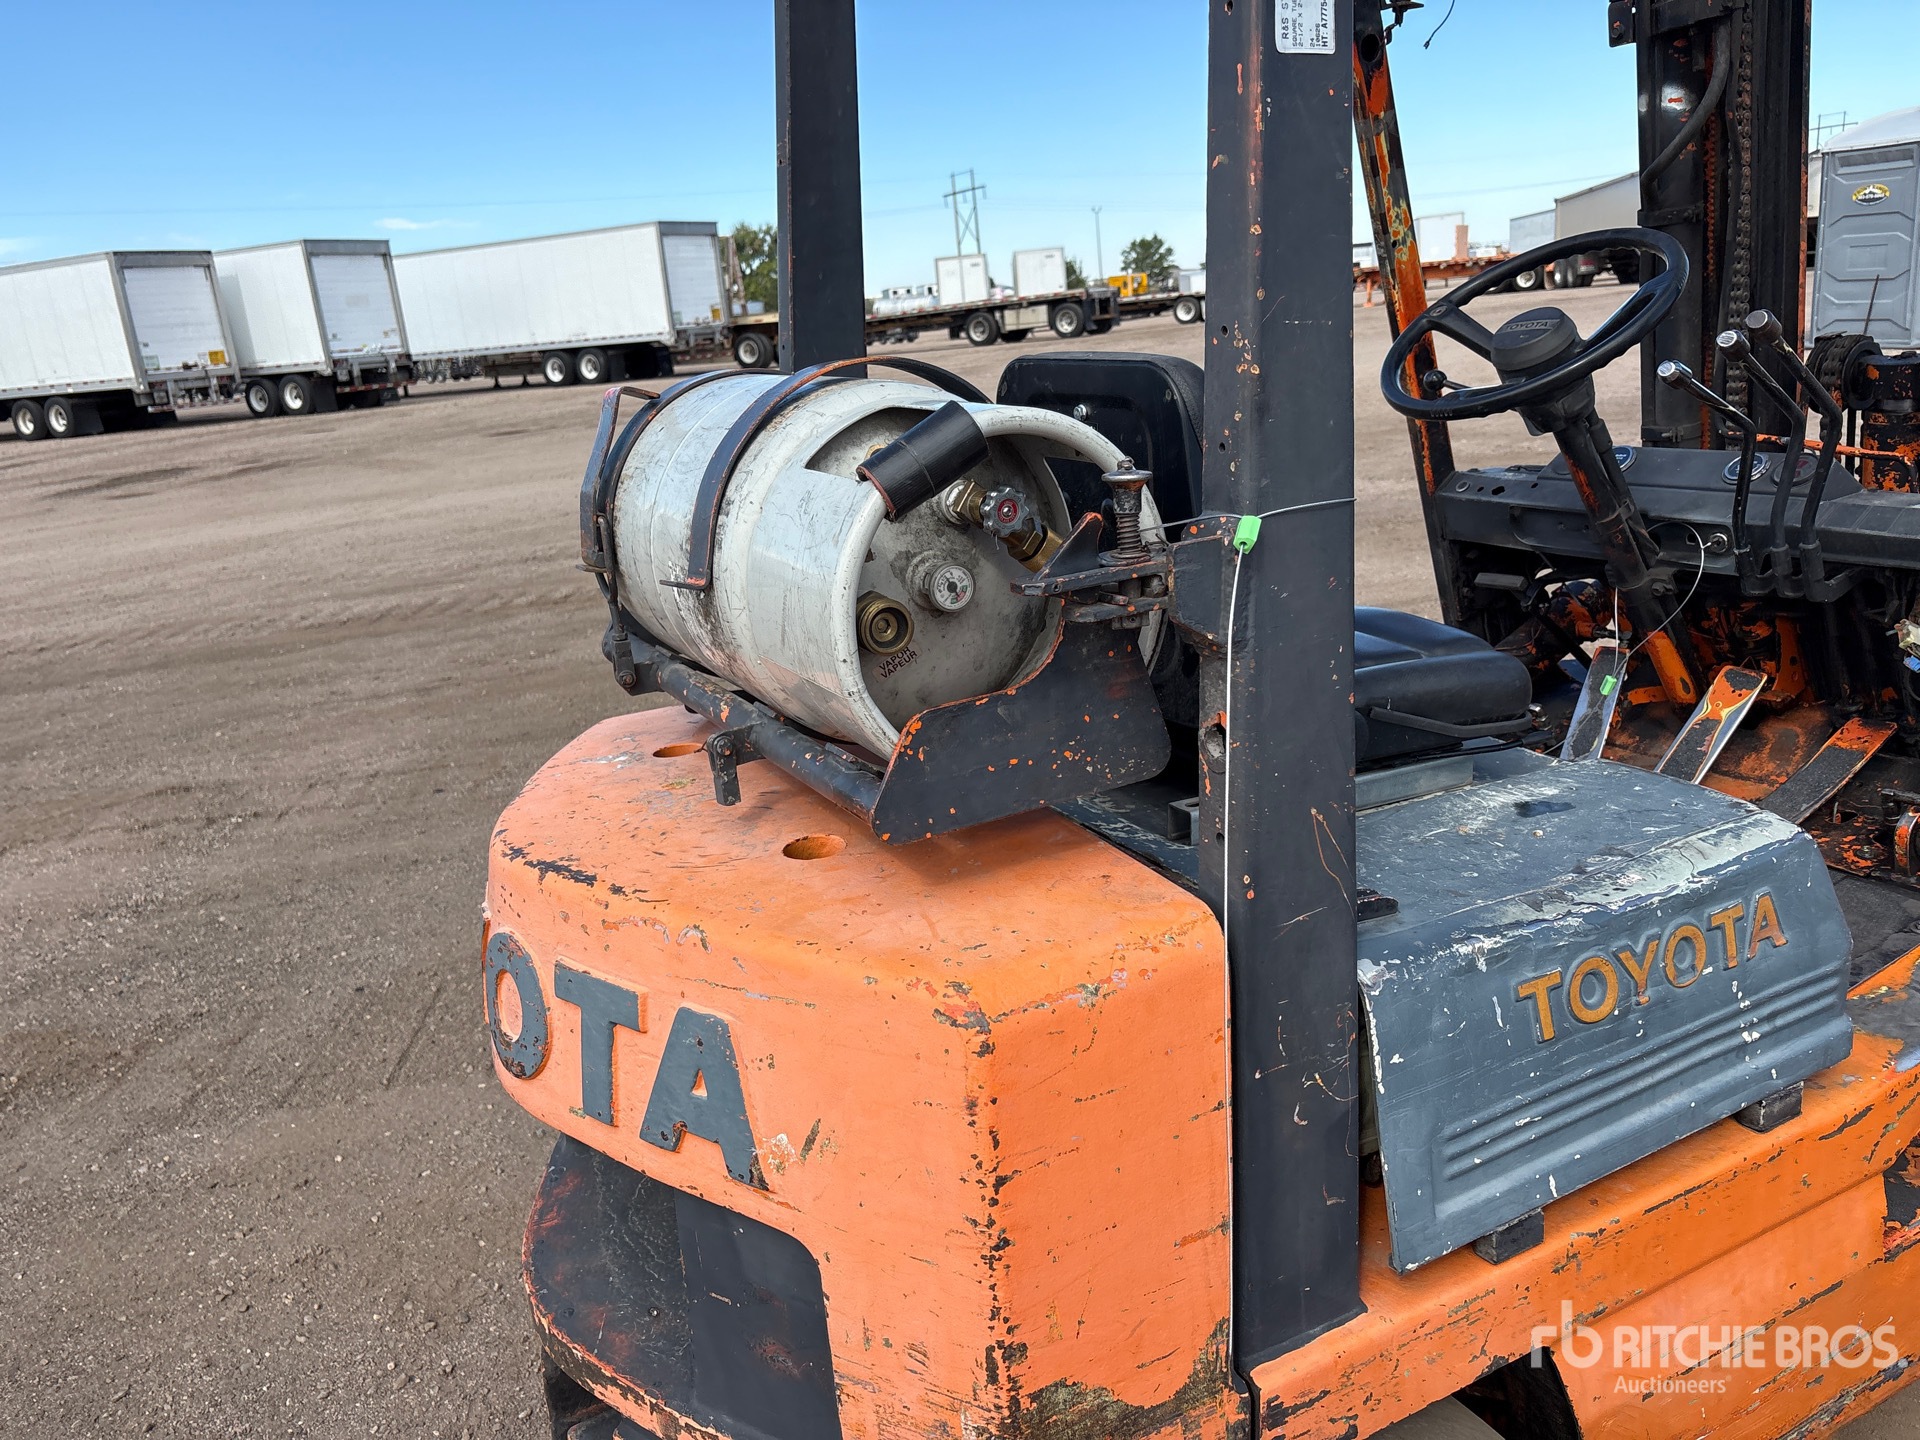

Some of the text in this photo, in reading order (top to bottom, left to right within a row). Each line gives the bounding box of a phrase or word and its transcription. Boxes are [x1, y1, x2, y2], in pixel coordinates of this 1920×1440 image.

[1282, 0, 1289, 10] S
[1506, 321, 1548, 330] TOYOTA
[880, 650, 918, 679] VAPEUR
[1516, 892, 1788, 1043] TOYOTA
